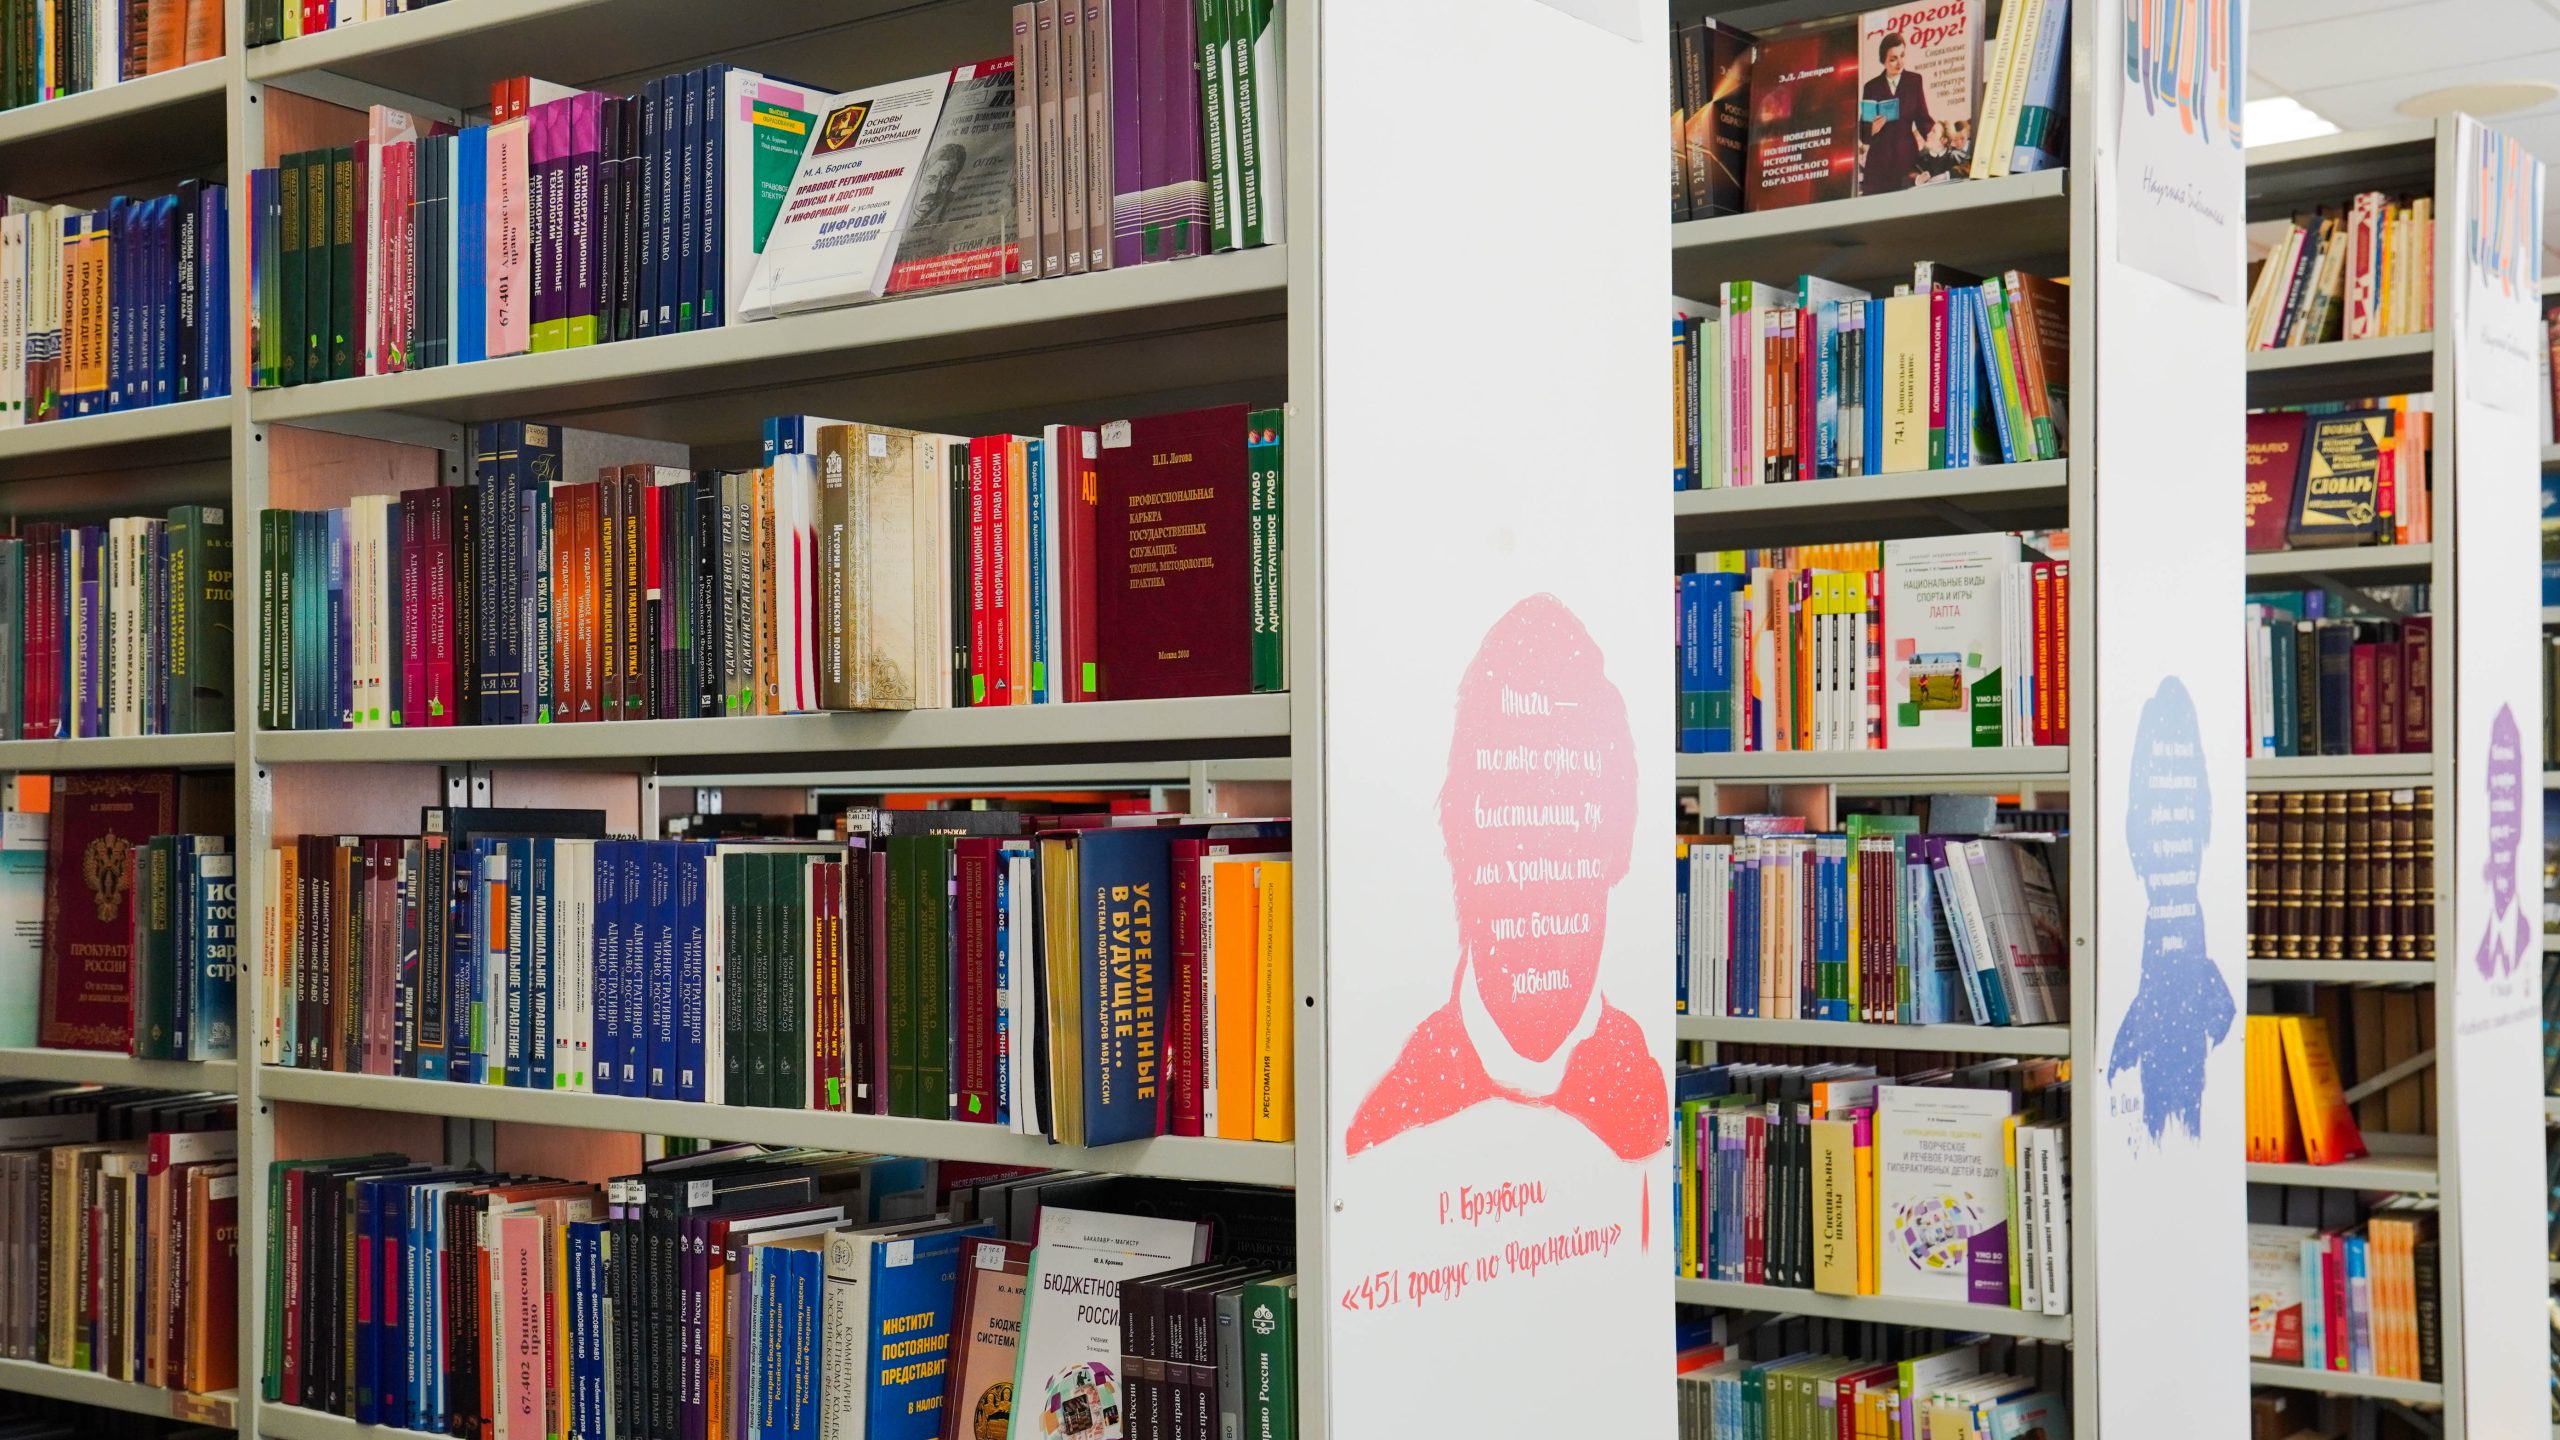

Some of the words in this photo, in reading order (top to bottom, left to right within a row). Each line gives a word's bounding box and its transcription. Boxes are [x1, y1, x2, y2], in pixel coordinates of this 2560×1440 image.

[1867, 1, 1964, 40] орогой
[1910, 17, 1966, 49] друг!
[1237, 38, 1247, 75] ОСНОВЫ
[1797, 66, 1834, 80] Днепров
[859, 127, 921, 146] ИНФОРМАЦИИ
[862, 124, 900, 137] ЗАЩИТЫ
[866, 114, 903, 127] ОСНОВЫ
[1239, 79, 1252, 166] ГОСУДАРСТВЕННОГО
[1783, 127, 1832, 142] НОВЕЙШАЯ
[1763, 154, 1802, 167] ИСТОРИЯ
[1764, 138, 1831, 156] ПОЛИТИЧЕСКАЯ
[705, 139, 714, 215] ТАМОЖЕННОЕ
[796, 179, 837, 196] ПРАВОВОЕ
[837, 167, 906, 188] РЕГУЛИРОВАНИЕ
[803, 169, 813, 178] М.
[814, 167, 823, 175] А.
[825, 160, 863, 175] Борисов
[1762, 158, 1829, 177] РОССИЙСКОГО
[1762, 169, 1829, 187] ОБРАЗОВАНИЯ
[573, 165, 582, 235] ТЕХНОЛОГИИ
[784, 215, 791, 225] К
[792, 204, 849, 223] ИНФОРМАЦИИ
[857, 200, 891, 213] условиях
[790, 196, 827, 211] ДОПУСКА
[829, 194, 835, 203] И
[836, 186, 874, 201] ДОСТУПА
[1246, 170, 1257, 227] УПРАВЛЕНИЯ
[186, 212, 194, 258] ПРОБЛЕМЫ
[579, 164, 589, 288] АНТИКОРРУПЦИОННЫЕ
[704, 218, 712, 253] ПРАВО
[811, 229, 881, 251] ЭКОНОМИКИ
[818, 211, 887, 236] ЦИФРОВОЙ
[510, 227, 518, 266] право
[186, 261, 194, 291] ОБЩЕЙ
[94, 259, 103, 369] ПРАВОВЕДЕНИЕ
[186, 293, 194, 327] ТЕОРИИ
[499, 275, 510, 327] 67.401
[1895, 420, 1905, 445] 74.1
[973, 456, 983, 491] РОССИИ
[1170, 452, 1193, 465] Лотова
[486, 475, 495, 524] СЛОВАРЬ
[1032, 494, 1040, 508] РФ
[1129, 487, 1214, 507] ПРОФЕССИОНАЛЬНАЯ
[1252, 471, 1262, 511] ПРАВО
[2311, 477, 2373, 495] СЛОВАРЬ
[973, 494, 983, 523] ПРАВО
[1129, 510, 1162, 524] КАРЬЕРА
[1129, 523, 1206, 542] ГОСУДАРСТВЕННЫХ
[627, 516, 636, 586] ГОСУДАРСТВЕННАЯ
[973, 525, 984, 610] ИНФОРМАЦИОННОЕ
[1032, 523, 1040, 607] административных
[1130, 544, 1177, 560] СЛУЖАЩИХ:
[1130, 562, 1159, 575] ТЕОРИЯ,
[1160, 557, 1214, 573] МЕТОДОЛОГИЯ,
[488, 526, 498, 657] ЭНЦИКЛОПЕДИЧЕСКИЙ
[1130, 577, 1165, 590] ПРАКТИКА
[1253, 515, 1265, 634] АДМИНИСТРАТИВНОЕ
[1904, 578, 1962, 589] НАЦИОНАЛЬНЫЕ
[1964, 576, 1985, 586] ВИДЫ
[177, 548, 185, 676] ГЛОБАЛИСТИКА
[1916, 592, 1944, 603] СПОРТА
[1946, 592, 1951, 600] И
[1953, 591, 1972, 600] ИГРЫ
[1929, 605, 1960, 618] ЛАПТА
[628, 588, 637, 643] ГРАЖДАНСКАЯ
[1032, 609, 1041, 662] правонаруш
[628, 645, 637, 677] СЛУЖБА
[1158, 650, 1177, 660] Москва
[1501, 684, 1552, 718] Книги
[1476, 745, 1539, 772] только
[1544, 747, 1581, 778] одно
[1474, 800, 1579, 833] вместилищ,
[1473, 861, 1503, 885] мы
[1507, 858, 1574, 884] храним
[1097, 887, 1107, 931] СИСТЕМА
[1111, 885, 1129, 902] В
[510, 895, 521, 988] МУНИЦИПАЛЬНОЕ
[1491, 916, 1527, 940] что
[1531, 911, 1591, 939] боимся
[599, 938, 607, 971] ПРАВО
[998, 950, 1006, 967] РФ
[1098, 934, 1108, 997] ПОДГОТОВКИ
[608, 922, 618, 1036] АДМИНИСТРАТИВНОЕ
[999, 974, 1007, 1017] КОДЕКС
[1110, 911, 1133, 1069] БУДУЩЕЕ...
[1132, 883, 1155, 1100] УСТРЕМЛЕННЫЕ
[1510, 966, 1573, 1003] забыть.
[598, 977, 607, 1020] РОССИИ
[1183, 964, 1192, 1066] МИГРАЦИОННОЕ
[509, 991, 521, 1059] УПРАВЛЕНИЕ
[1099, 1000, 1109, 1040] КАДРОВ
[998, 1022, 1007, 1107] ТАМОЖЕННЫЙ
[1100, 1042, 1110, 1064] МВД
[1101, 1067, 1111, 1105] РОССИИ
[1183, 1069, 1191, 1109] ПРАВО
[1262, 1056, 1272, 1119] ХРЕСТОМАТИЯ
[1904, 1152, 1908, 1160] И
[1910, 1152, 1942, 1162] РЕЧЕВОЕ
[1944, 1155, 1982, 1164] РАЗВИТИЕ
[1919, 1141, 1966, 1152] ТВОРЧЕСКОЕ
[1887, 1163, 1949, 1175] ГИПЕРАКТИВНЫХ
[1951, 1166, 1974, 1176] ДЕТЕЙ
[1983, 1169, 1999, 1178] ДОУ
[1440, 1191, 1454, 1225] Р.
[1460, 1180, 1546, 1227] Брэдбери
[1823, 1149, 1833, 1240] Специальные
[1835, 1194, 1844, 1240] школы
[1341, 1269, 1400, 1311] «451
[1408, 1261, 1469, 1307] градус
[1477, 1255, 1499, 1282] по
[1505, 1223, 1621, 1278] Фаренгейту»
[1824, 1243, 1833, 1268] 74.3
[520, 1247, 530, 1356] Финансовое
[768, 1274, 777, 1307] кодексу
[693, 1291, 703, 1325] России
[883, 1312, 935, 1336] ИНСТИТУТ
[989, 1317, 1021, 1333] БЮДЖЕ
[530, 1303, 541, 1356] право
[693, 1328, 703, 1356] право
[766, 1308, 777, 1362] Бюджетному
[775, 1302, 784, 1350] Федерации
[976, 1332, 1015, 1348] СИСТЕМА
[882, 1333, 950, 1361] ПОСТОЯННОГ
[521, 1361, 531, 1415] 67.402
[692, 1358, 702, 1405] Валютное
[775, 1351, 783, 1401] Российской
[881, 1359, 947, 1386] ПРЕДСТАВИТ
[766, 1370, 775, 1427] Комментарий
